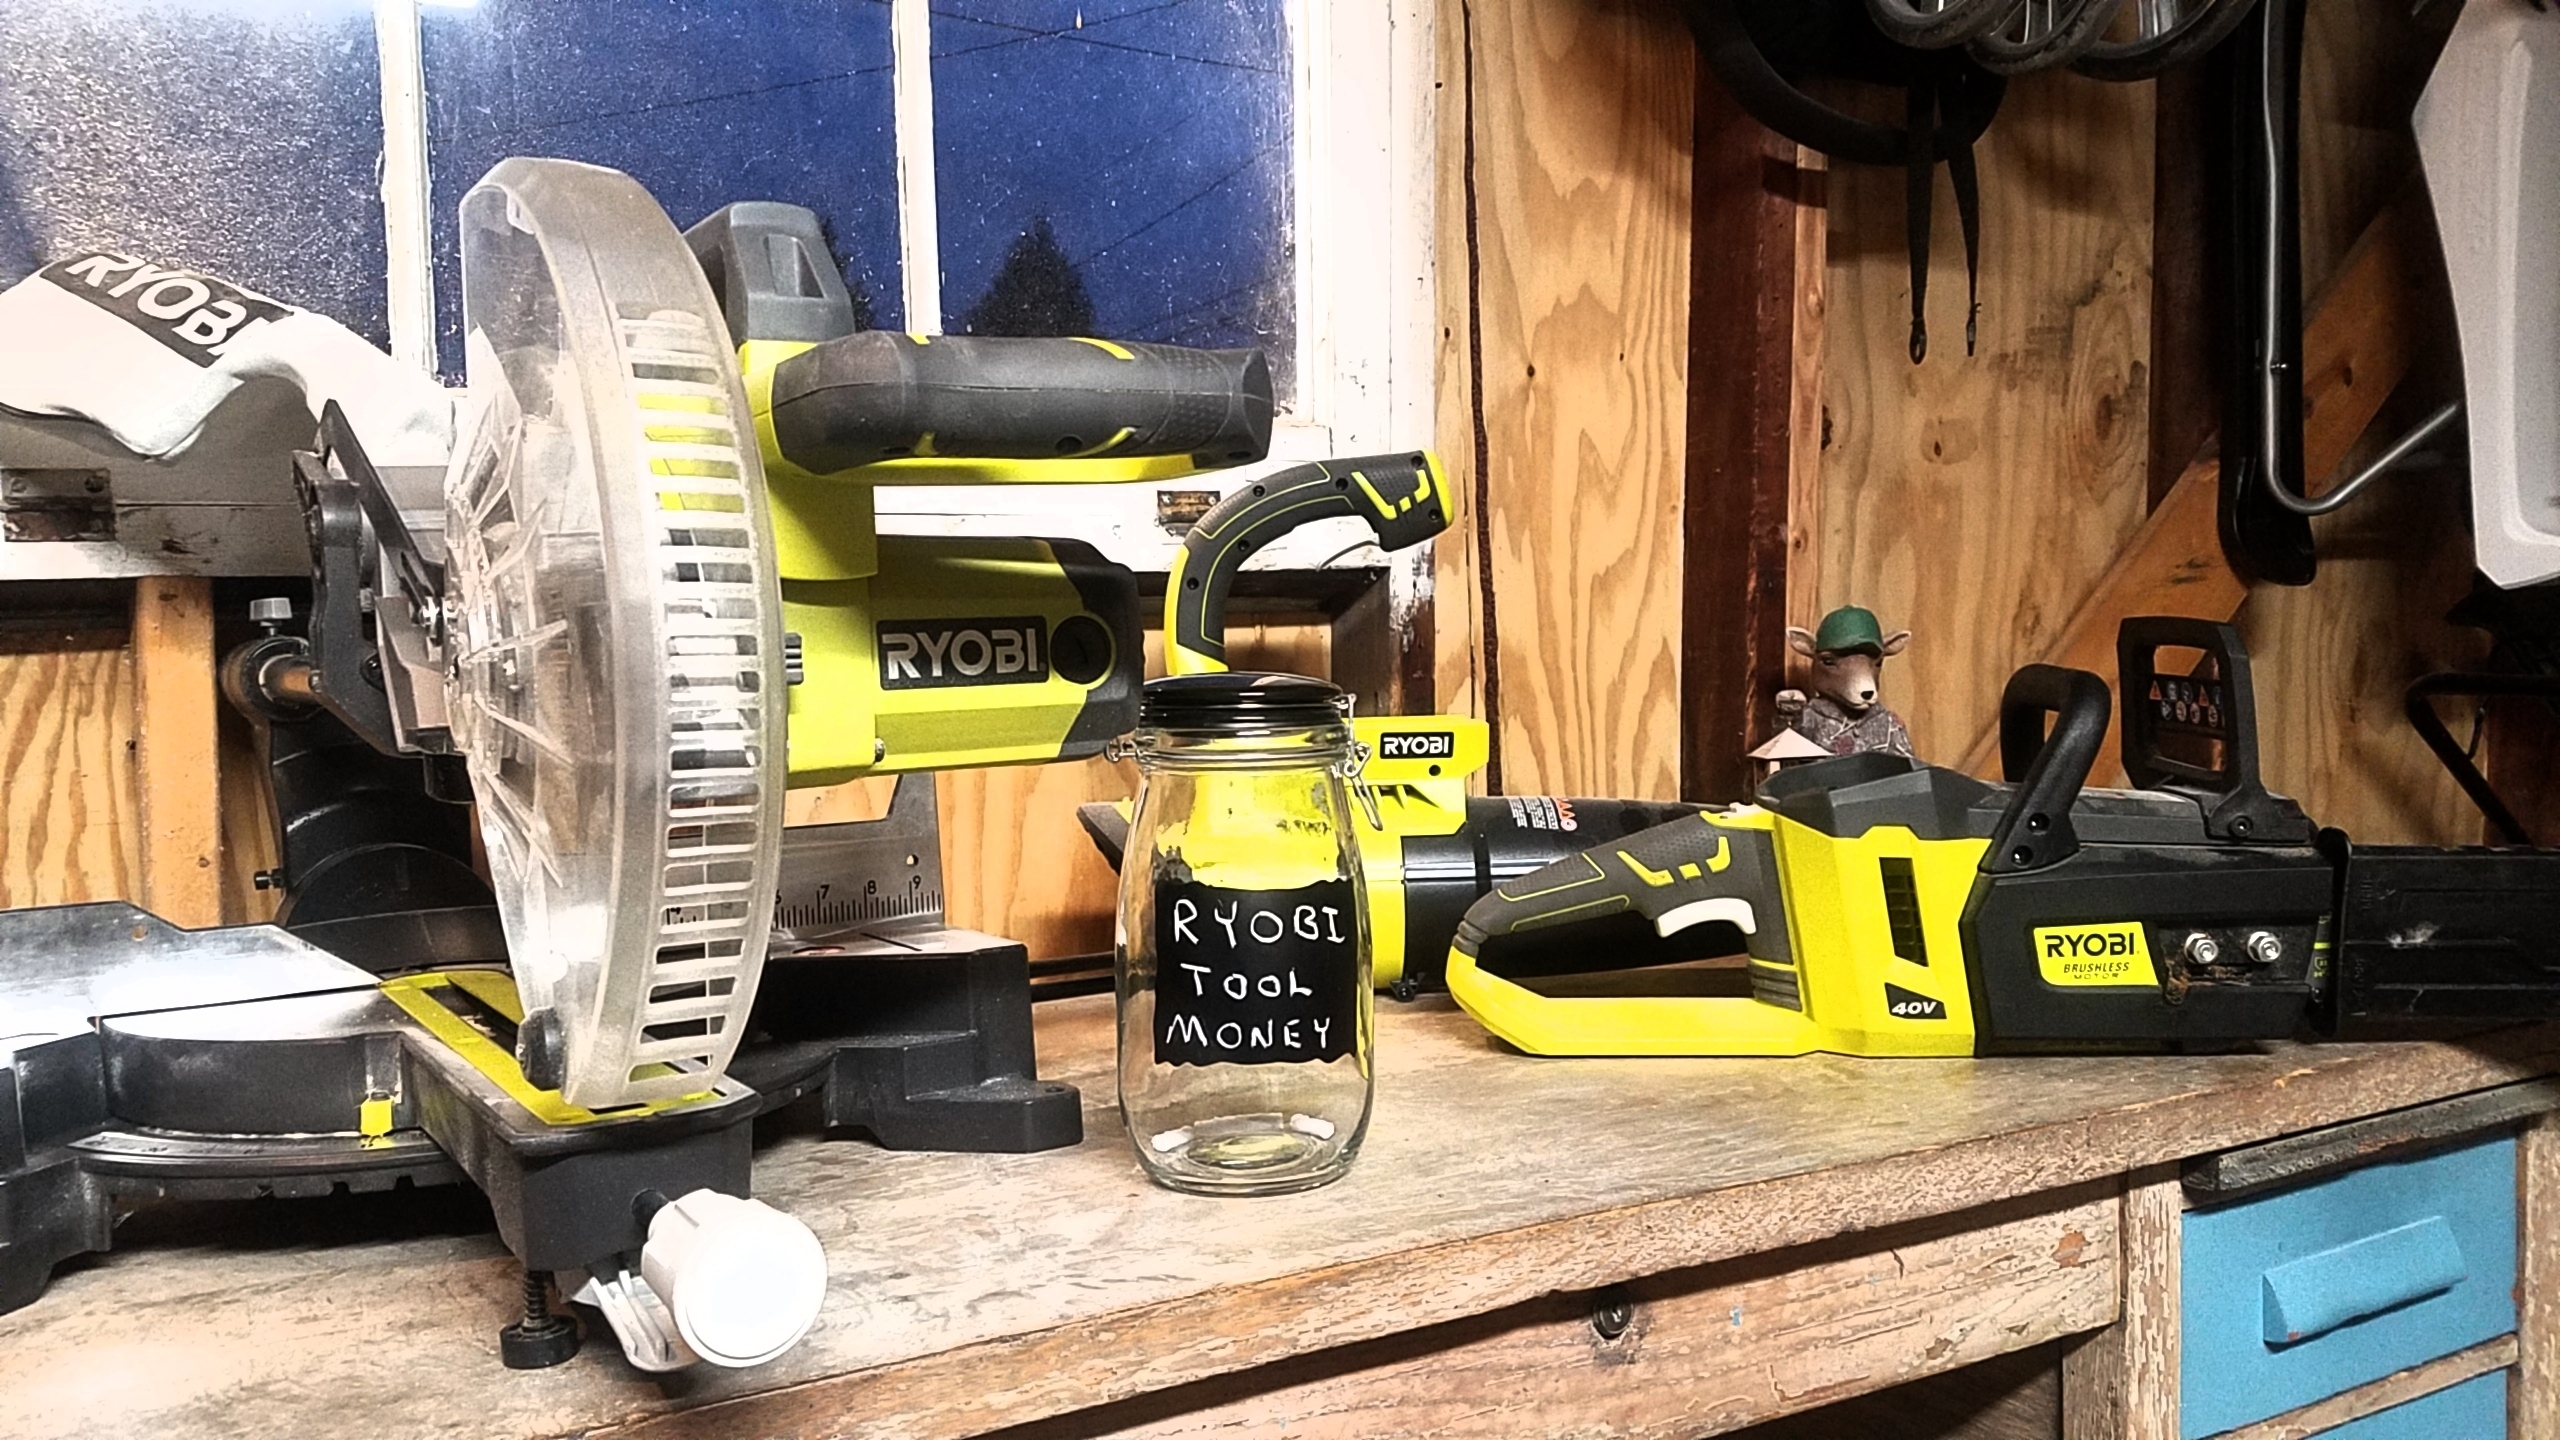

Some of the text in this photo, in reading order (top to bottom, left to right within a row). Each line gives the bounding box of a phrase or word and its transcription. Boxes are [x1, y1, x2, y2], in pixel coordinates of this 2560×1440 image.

[881, 628, 1039, 680] RYOBI
[1383, 735, 1449, 755] RYOBI
[820, 884, 830, 900] 7
[867, 880, 877, 895] 8
[912, 875, 922, 889] 9
[1173, 898, 1346, 949] RYOBI
[2044, 932, 2135, 958] RYOBI
[2063, 961, 2130, 974] BRUSHLESS
[1180, 962, 1313, 1000] TOOL
[1891, 1001, 1938, 1015] 40V
[1166, 1013, 1331, 1049] MONEY
